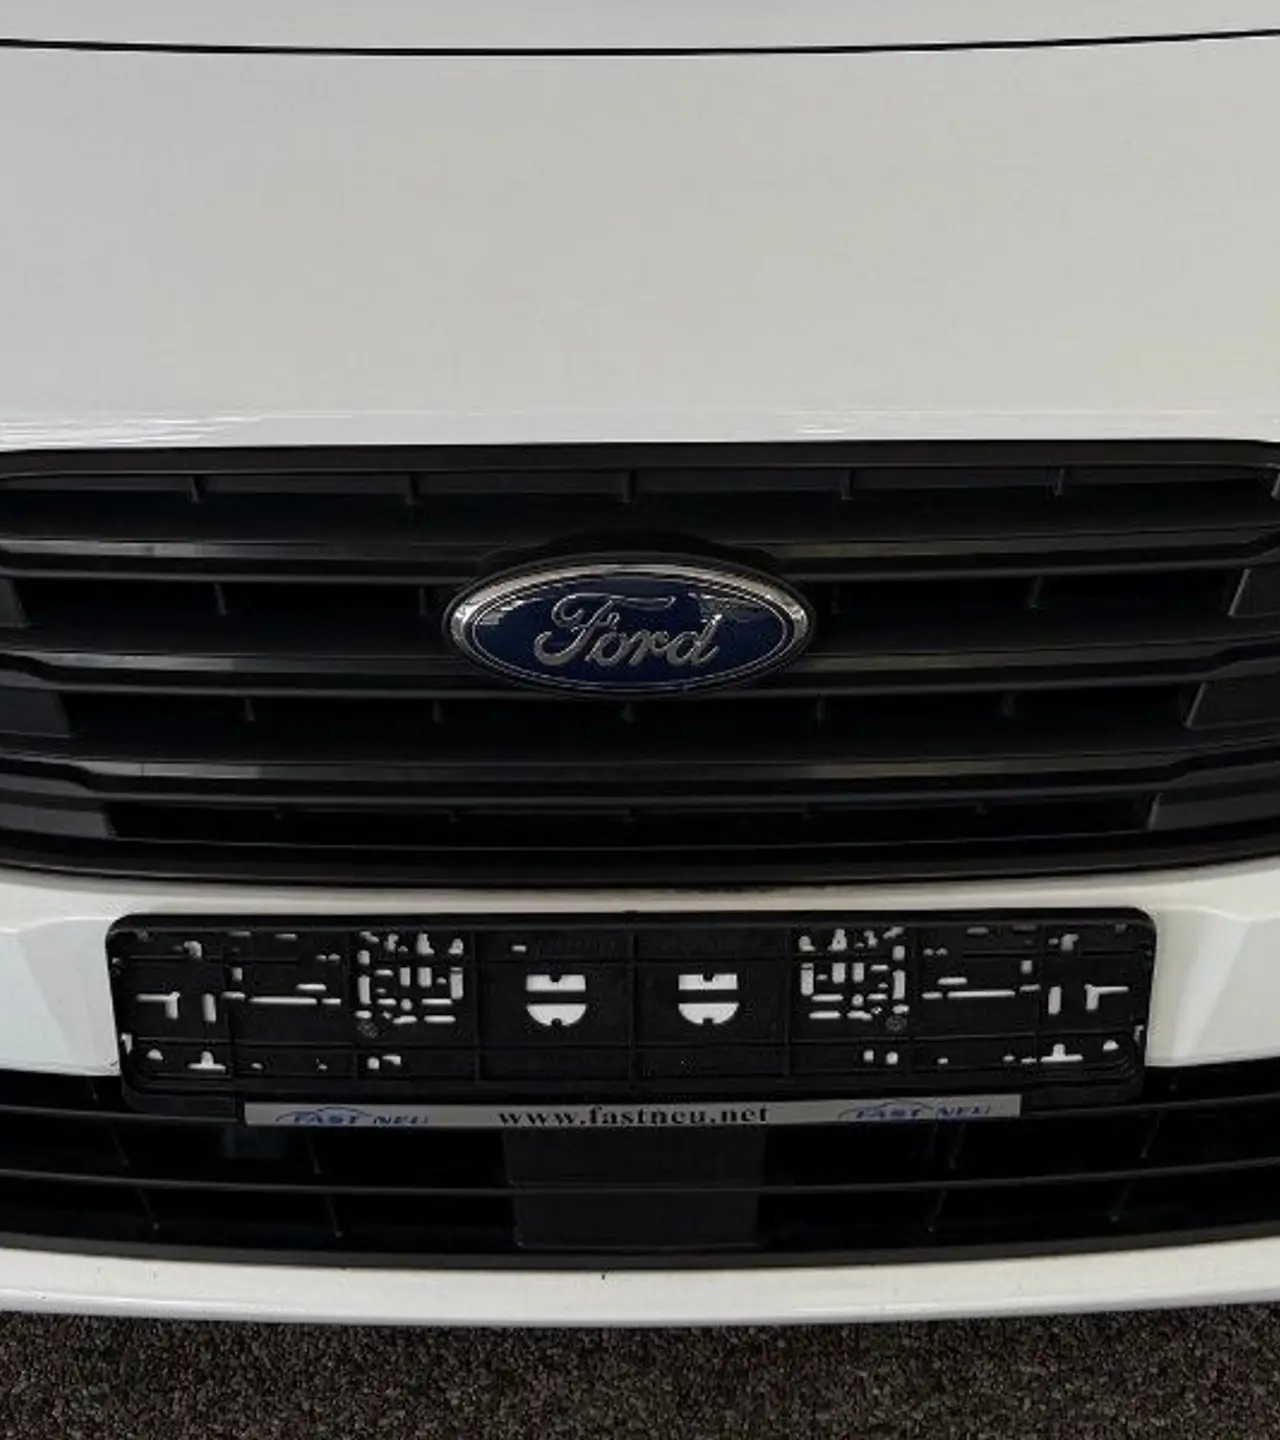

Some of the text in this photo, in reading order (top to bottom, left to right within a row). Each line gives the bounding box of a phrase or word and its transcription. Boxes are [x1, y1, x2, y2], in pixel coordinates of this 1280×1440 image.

[532, 591, 723, 667] Ford
[293, 1113, 359, 1125] FAST
[496, 1104, 770, 1126] www.fastneu.net
[854, 1107, 923, 1120] FAST
